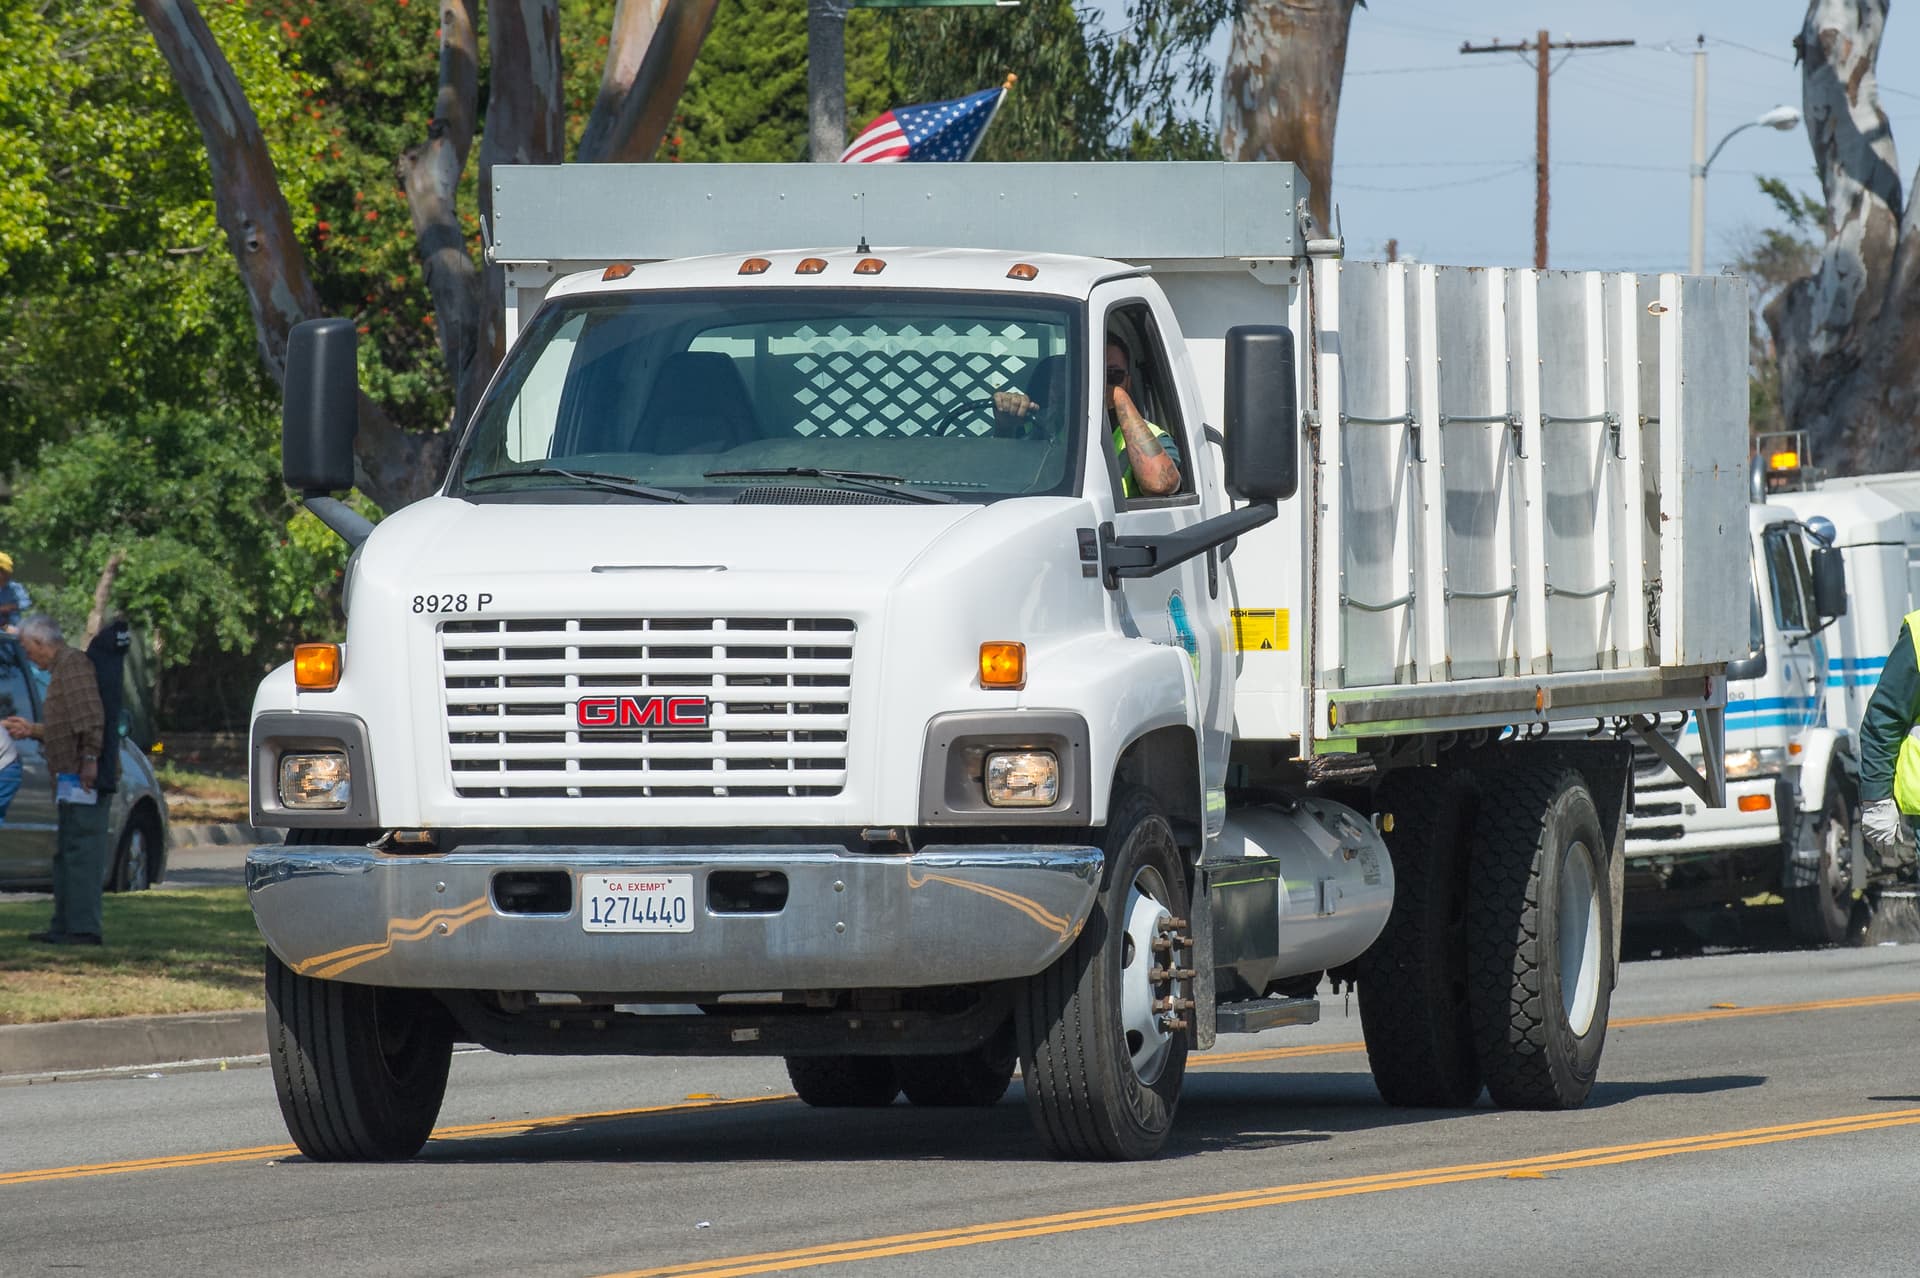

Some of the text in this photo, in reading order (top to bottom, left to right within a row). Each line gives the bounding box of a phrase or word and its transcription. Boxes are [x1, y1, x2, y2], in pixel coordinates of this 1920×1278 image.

[412, 593, 493, 614] 8928 P
[577, 696, 707, 727] GMC
[609, 882, 667, 892] CA EXEMPT
[590, 896, 686, 924] 1274440
